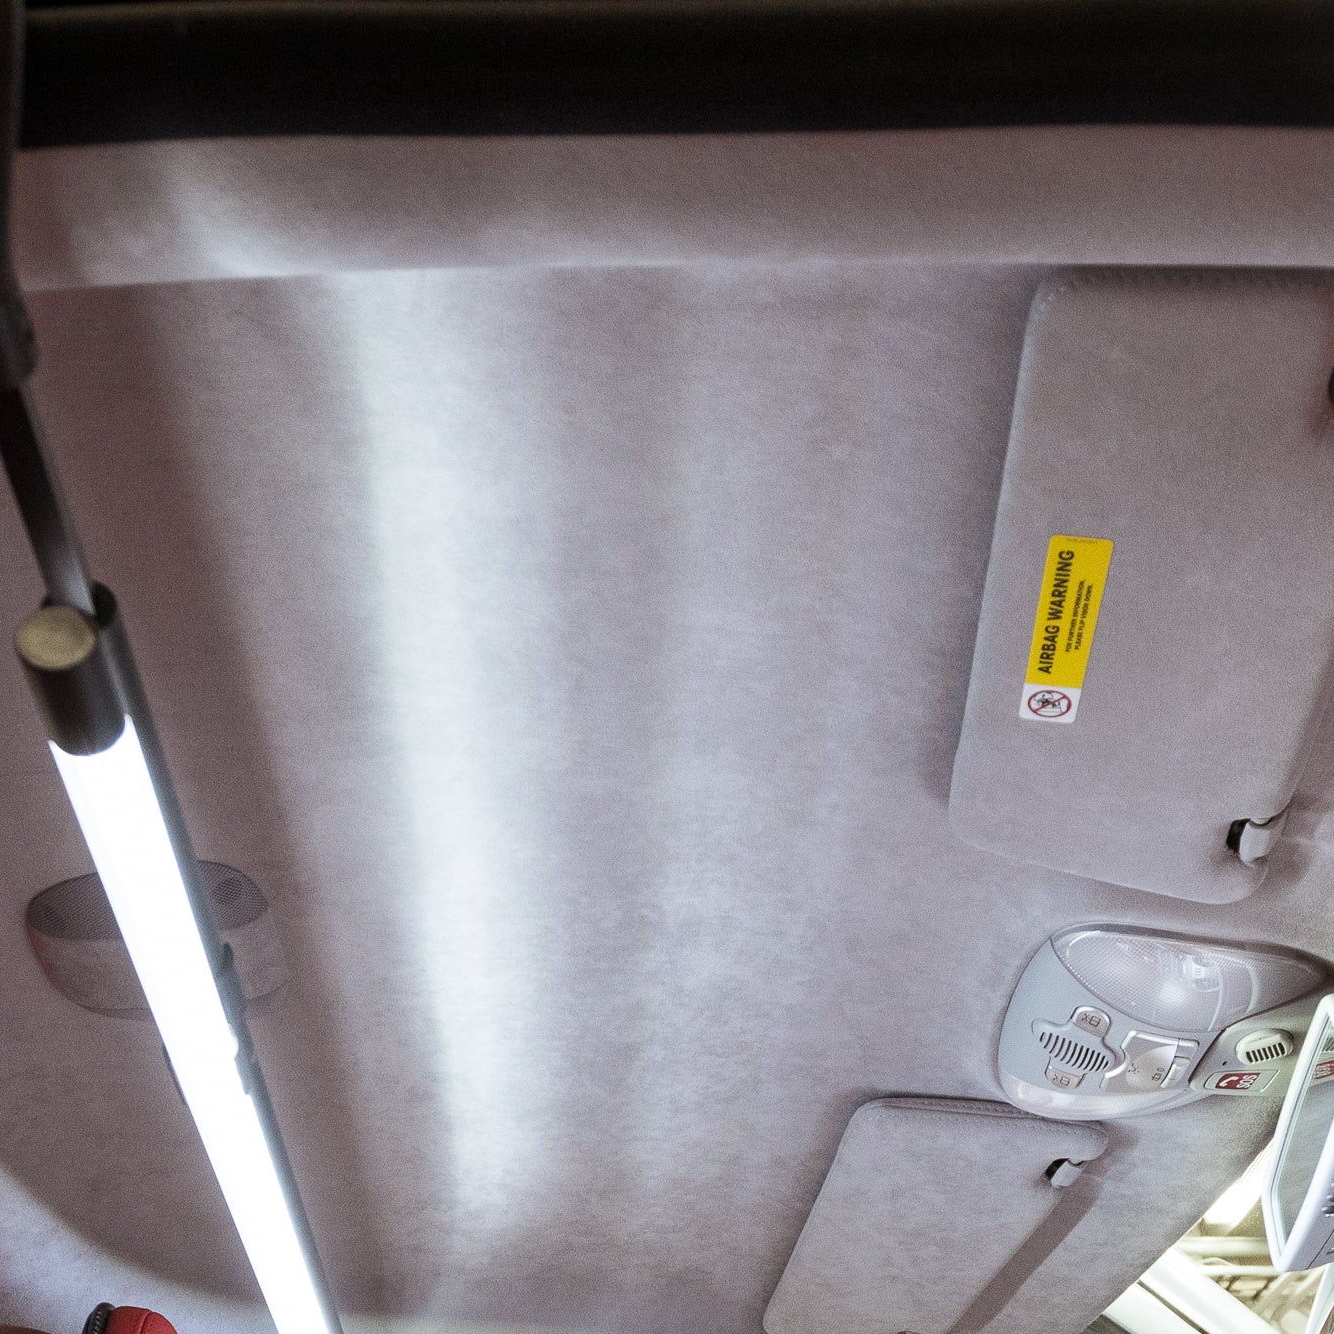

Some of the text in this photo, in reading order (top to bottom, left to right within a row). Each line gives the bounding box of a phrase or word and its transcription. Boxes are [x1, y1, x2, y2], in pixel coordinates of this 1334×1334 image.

[1037, 550, 1075, 675] AIRBAG WARNING
[1067, 618, 1077, 641] FURTHER
[1065, 642, 1073, 652] FOR
[1074, 631, 1084, 650] PLEASE
[1236, 1074, 1258, 1089] SOS
